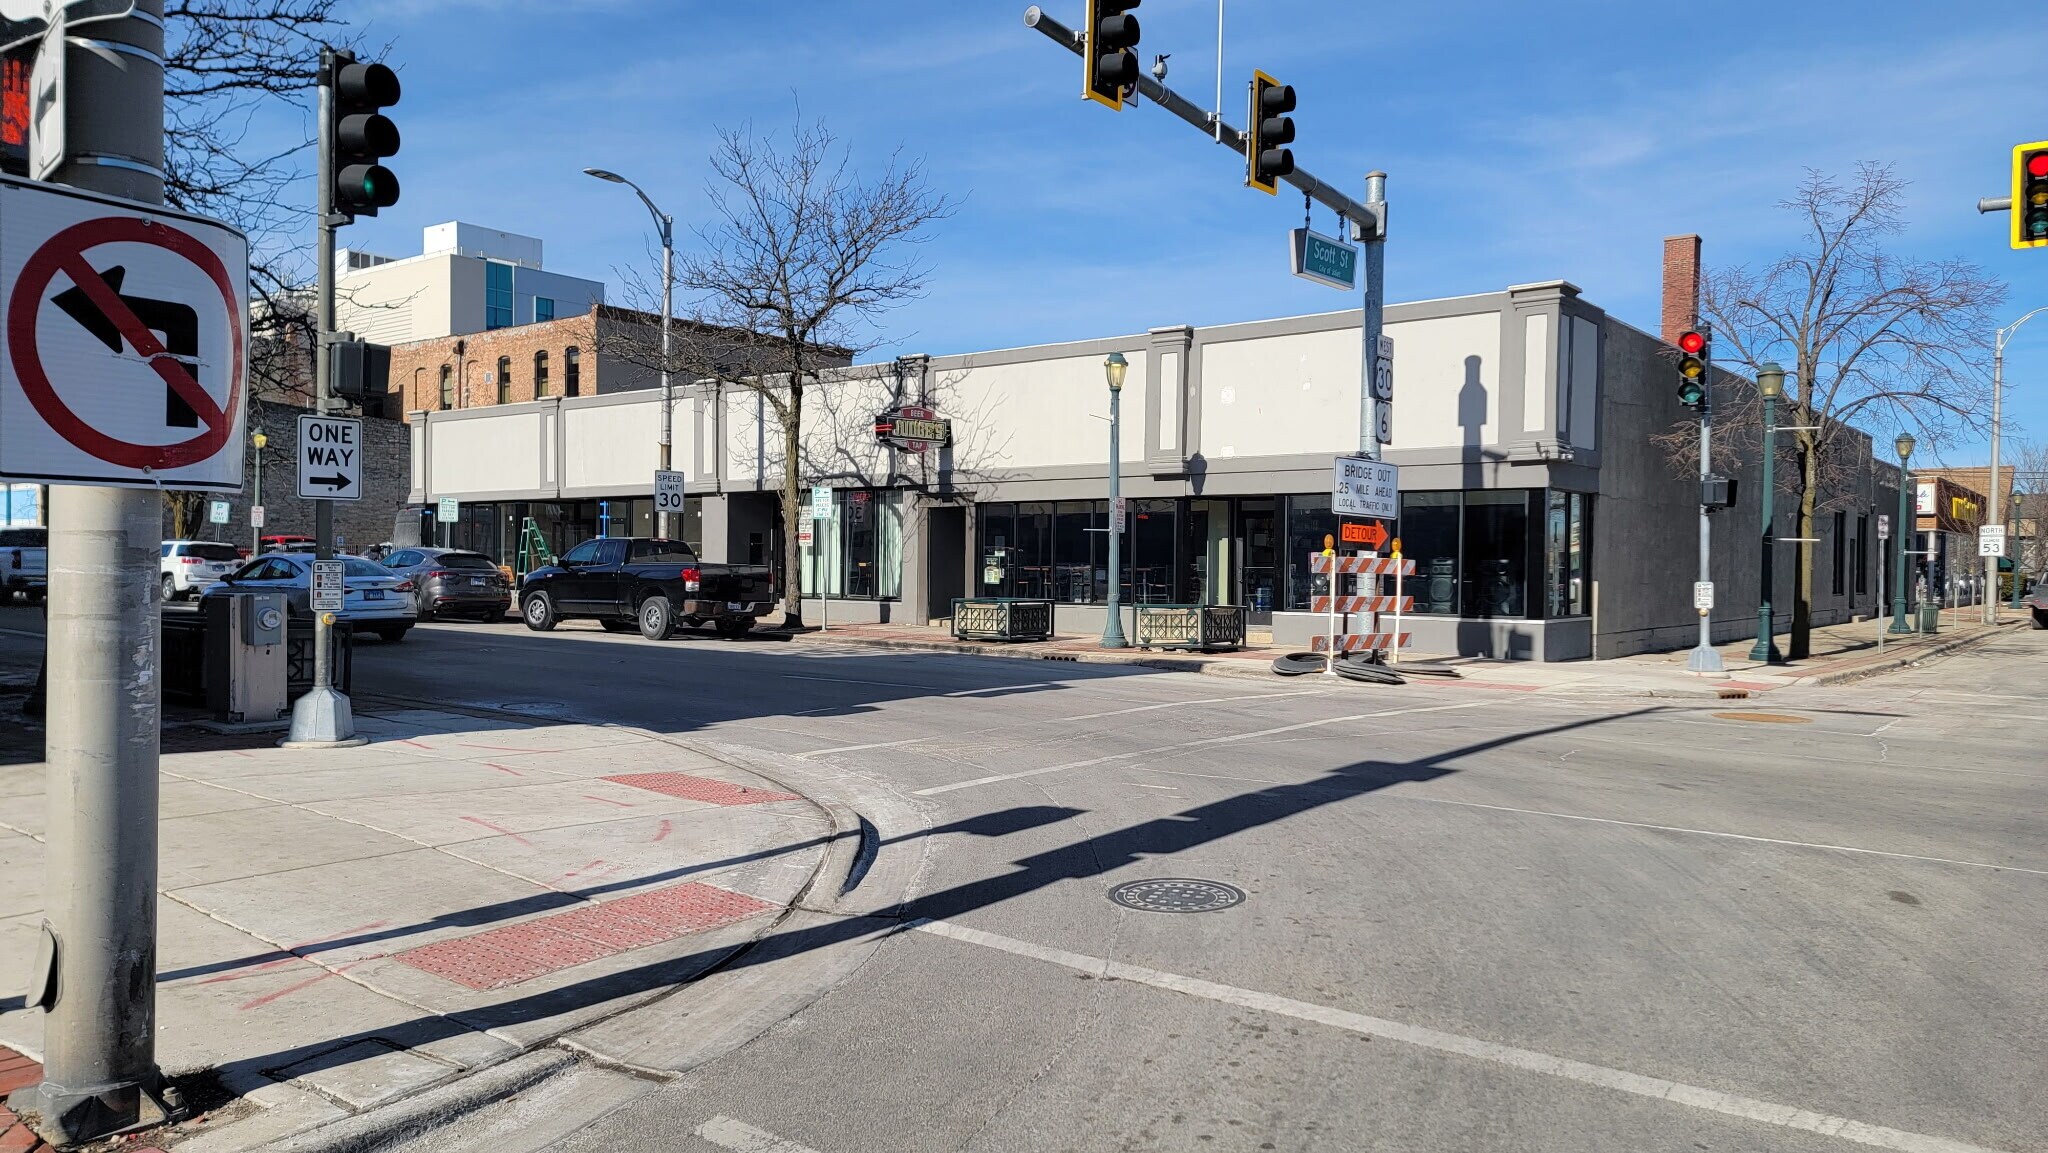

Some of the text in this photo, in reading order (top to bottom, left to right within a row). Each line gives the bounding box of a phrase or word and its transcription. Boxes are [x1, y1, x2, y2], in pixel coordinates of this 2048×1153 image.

[1314, 241, 1349, 269] Scott St
[1378, 366, 1392, 391] 30
[910, 409, 925, 418] BEER
[1381, 411, 1388, 434] 6
[309, 423, 353, 444] ONE
[307, 446, 354, 467] WAY
[657, 474, 682, 483] SPEED
[1344, 464, 1392, 483] BRIDGE OUT
[1335, 481, 1393, 499] .25 MILE AHEAD
[216, 503, 224, 511] P
[658, 492, 681, 508] 30
[1338, 498, 1394, 513] LOCAL TRAFFIC ONLY
[1344, 526, 1377, 541] DETOUR
[1983, 543, 2000, 553] 53
